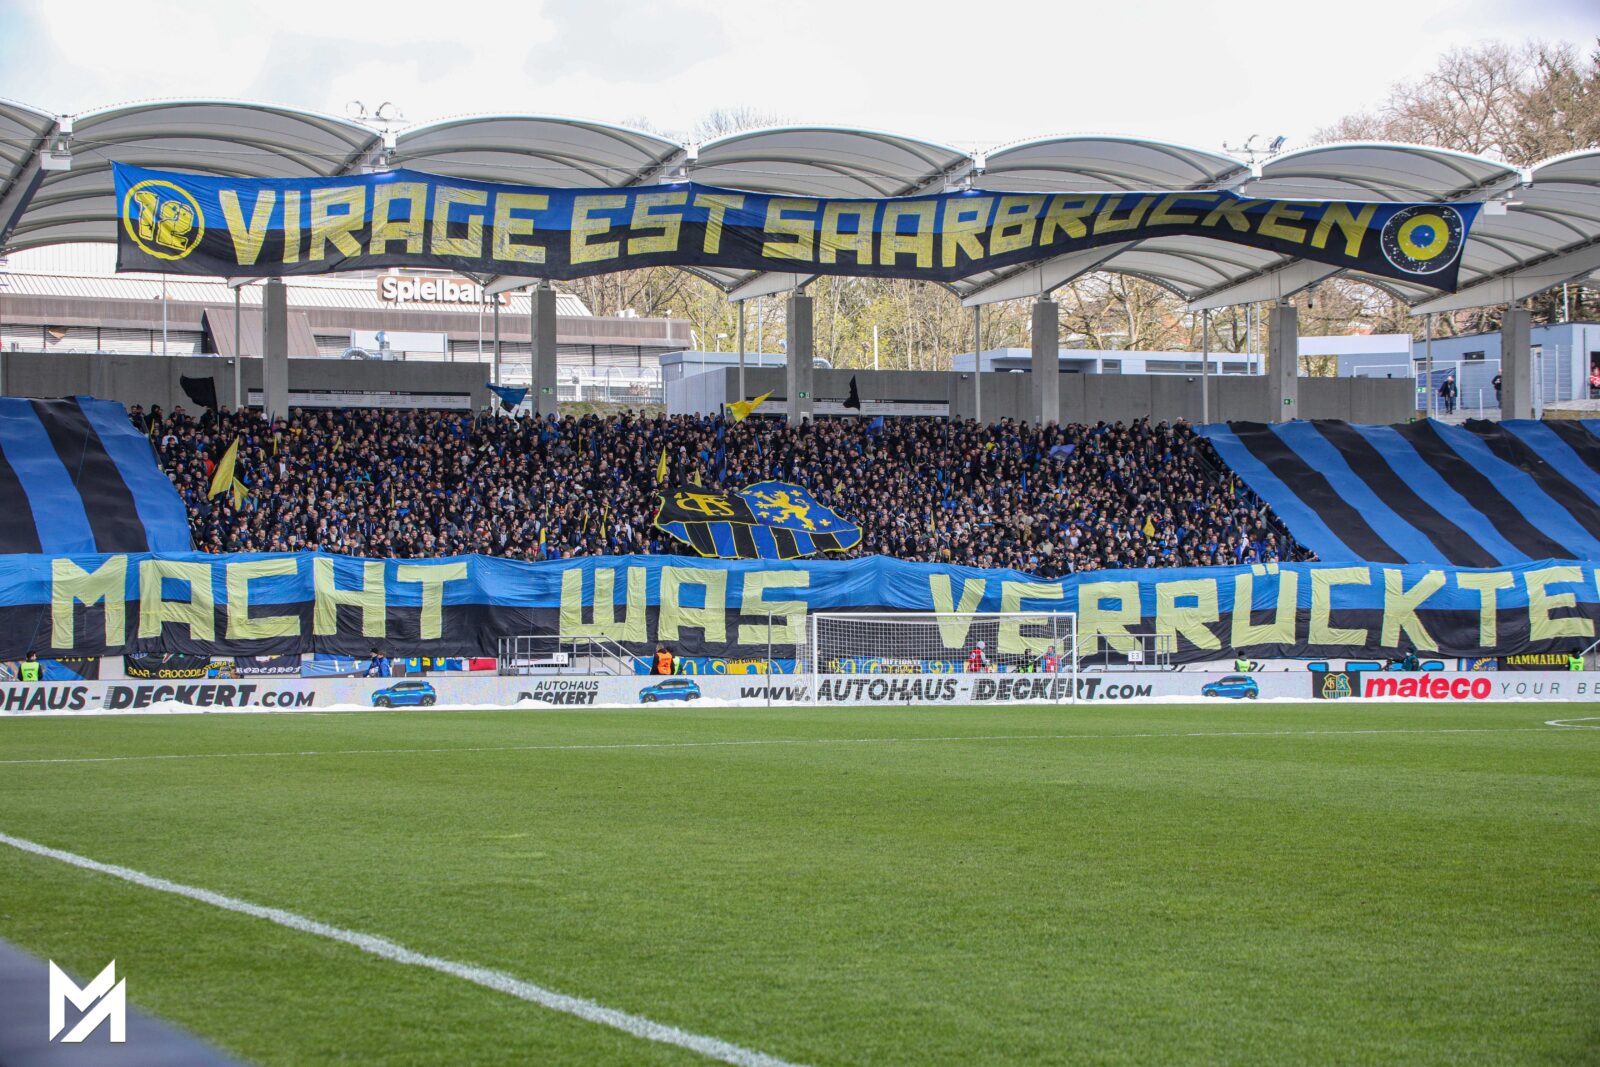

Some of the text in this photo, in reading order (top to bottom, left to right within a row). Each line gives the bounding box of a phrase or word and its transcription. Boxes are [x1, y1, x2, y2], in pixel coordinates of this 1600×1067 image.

[219, 182, 549, 266] VIRAGE
[570, 191, 745, 265] EST
[51, 554, 1600, 656] MACHT WAS VERRÜCKTE
[535, 681, 599, 691] AUTOHAUS
[1365, 673, 1492, 700] mateco
[1501, 682, 1560, 694] YOUR
